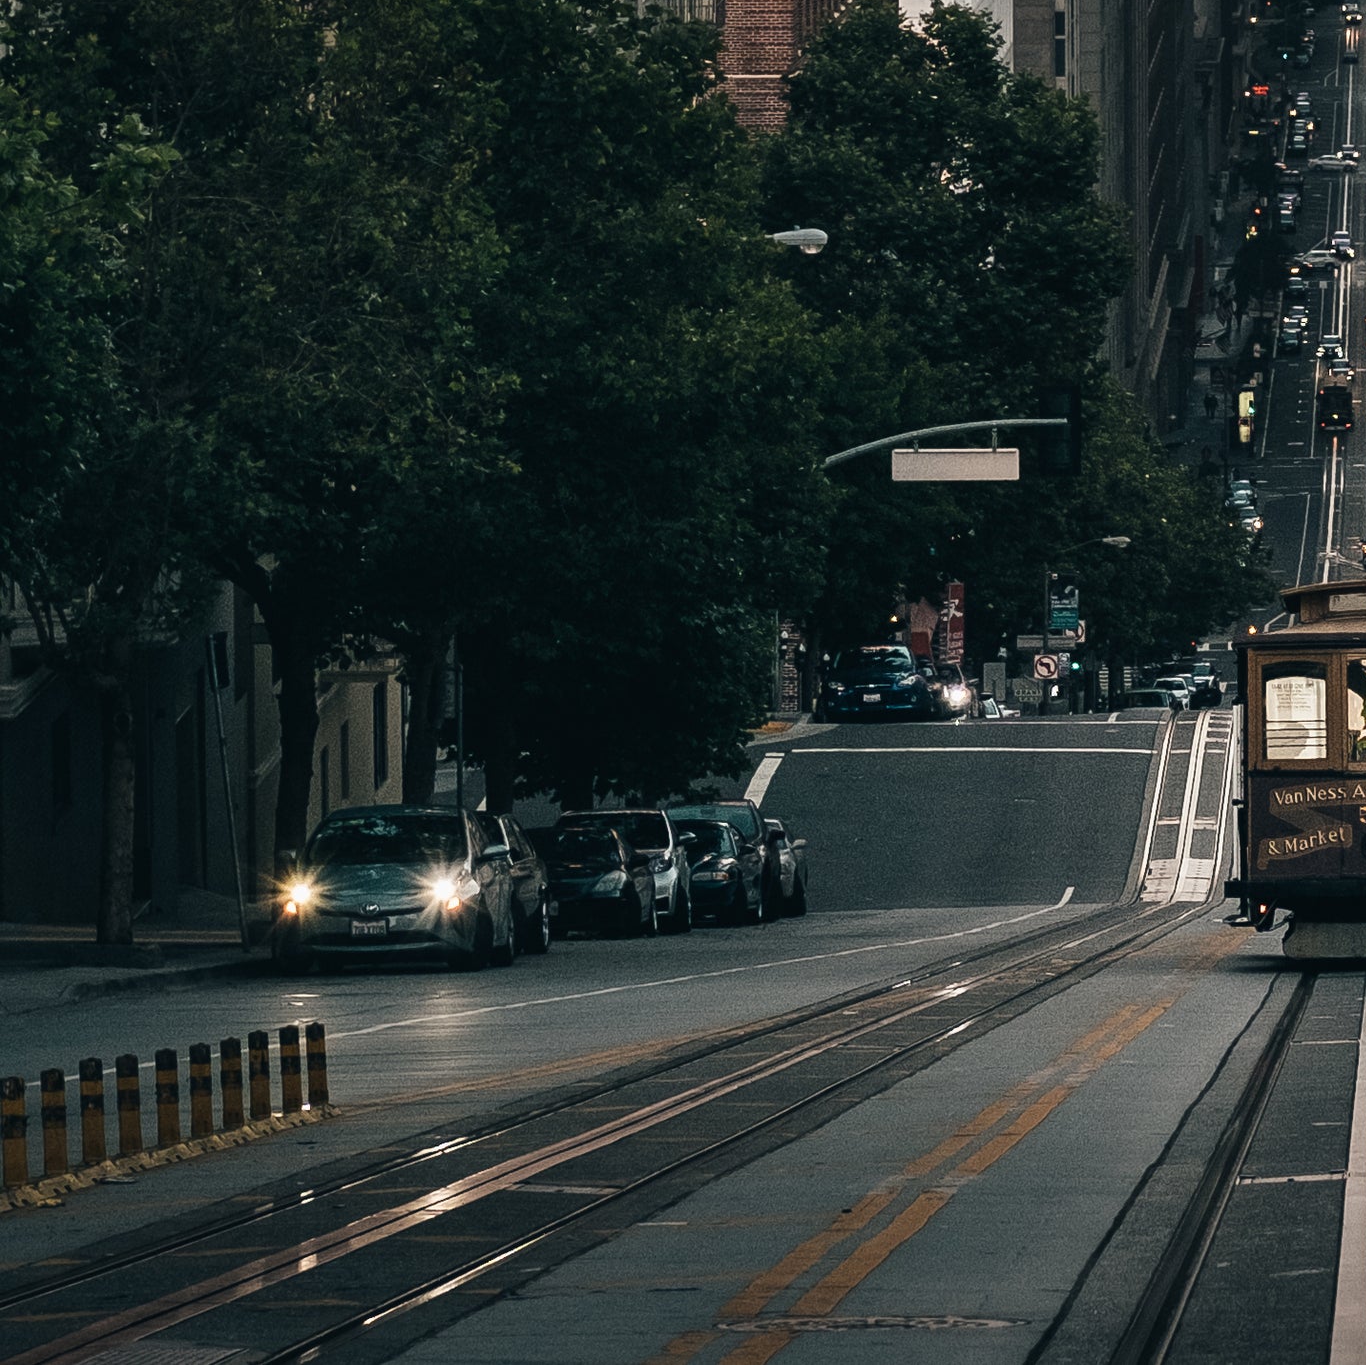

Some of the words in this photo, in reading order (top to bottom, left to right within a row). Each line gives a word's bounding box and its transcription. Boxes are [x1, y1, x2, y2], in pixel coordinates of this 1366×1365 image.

[1275, 790, 1303, 805] Van
[1306, 786, 1346, 802] Ness
[1268, 840, 1281, 855] &
[1284, 826, 1346, 853] Market
